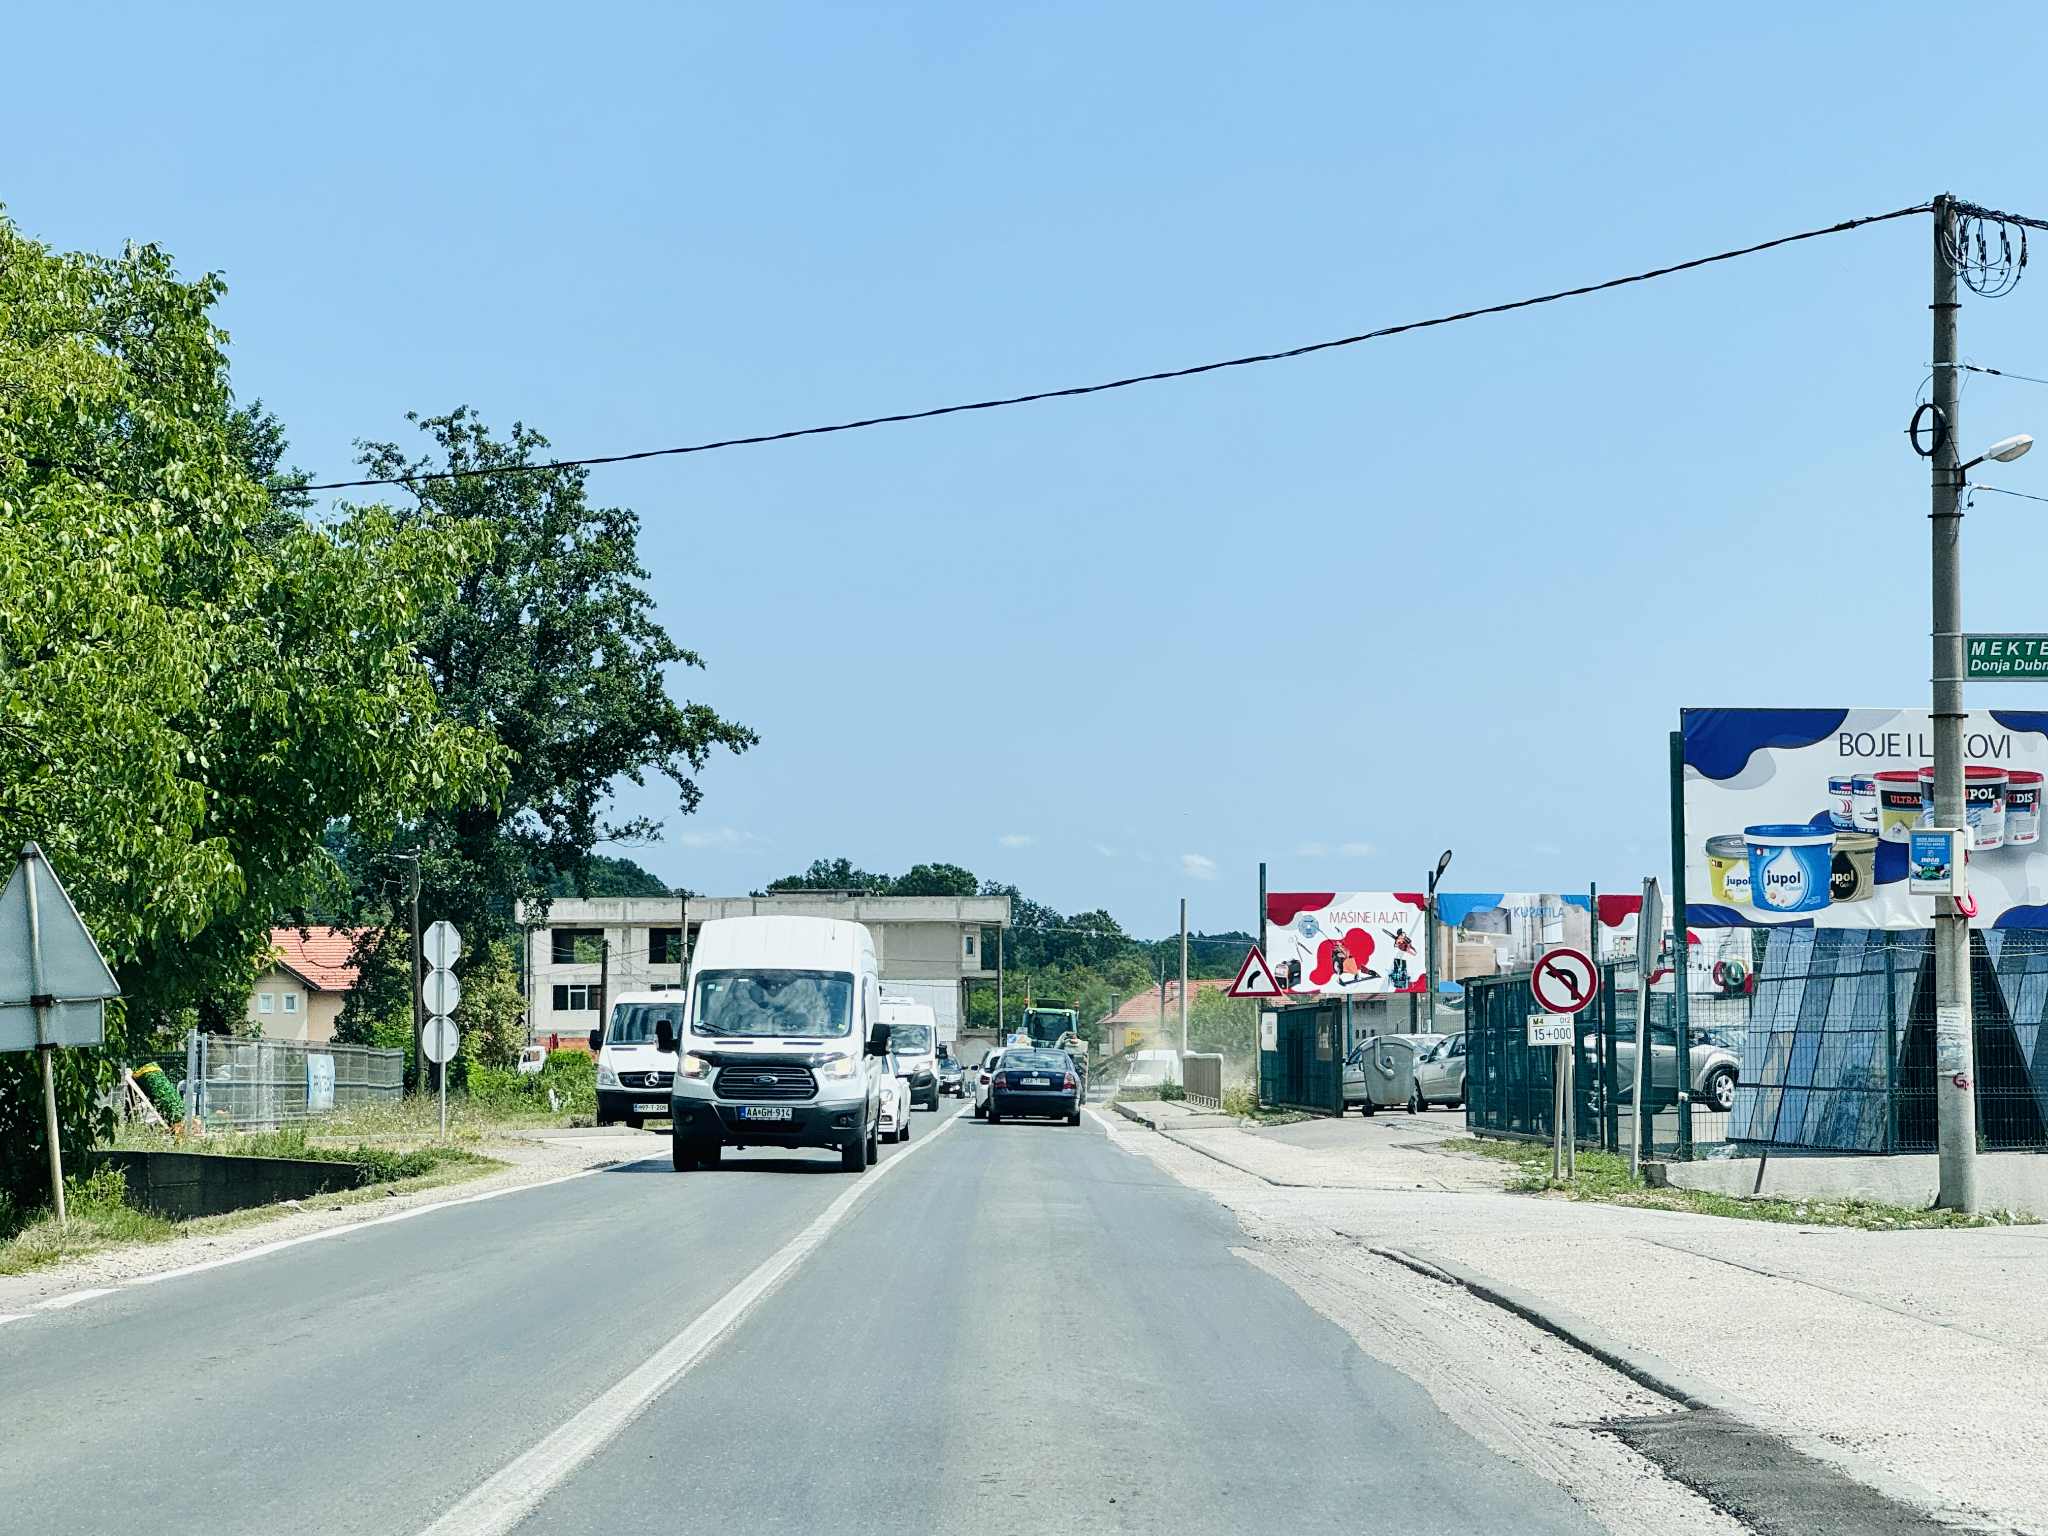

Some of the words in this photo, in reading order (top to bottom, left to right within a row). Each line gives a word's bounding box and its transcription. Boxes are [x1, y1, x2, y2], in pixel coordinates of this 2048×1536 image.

[1971, 659, 2010, 673] Donja
[1839, 732, 1901, 758] BOJE
[1907, 733, 1911, 757] I
[1919, 733, 2011, 759] LOVI
[1726, 874, 1751, 888] jupol
[1766, 869, 1801, 887] jupol
[1831, 870, 1855, 885] upol
[1378, 911, 1408, 924] ALATI
[1512, 905, 1564, 919] KUPATILA
[1532, 1017, 1544, 1025] M4
[1534, 1027, 1572, 1041] 15+000
